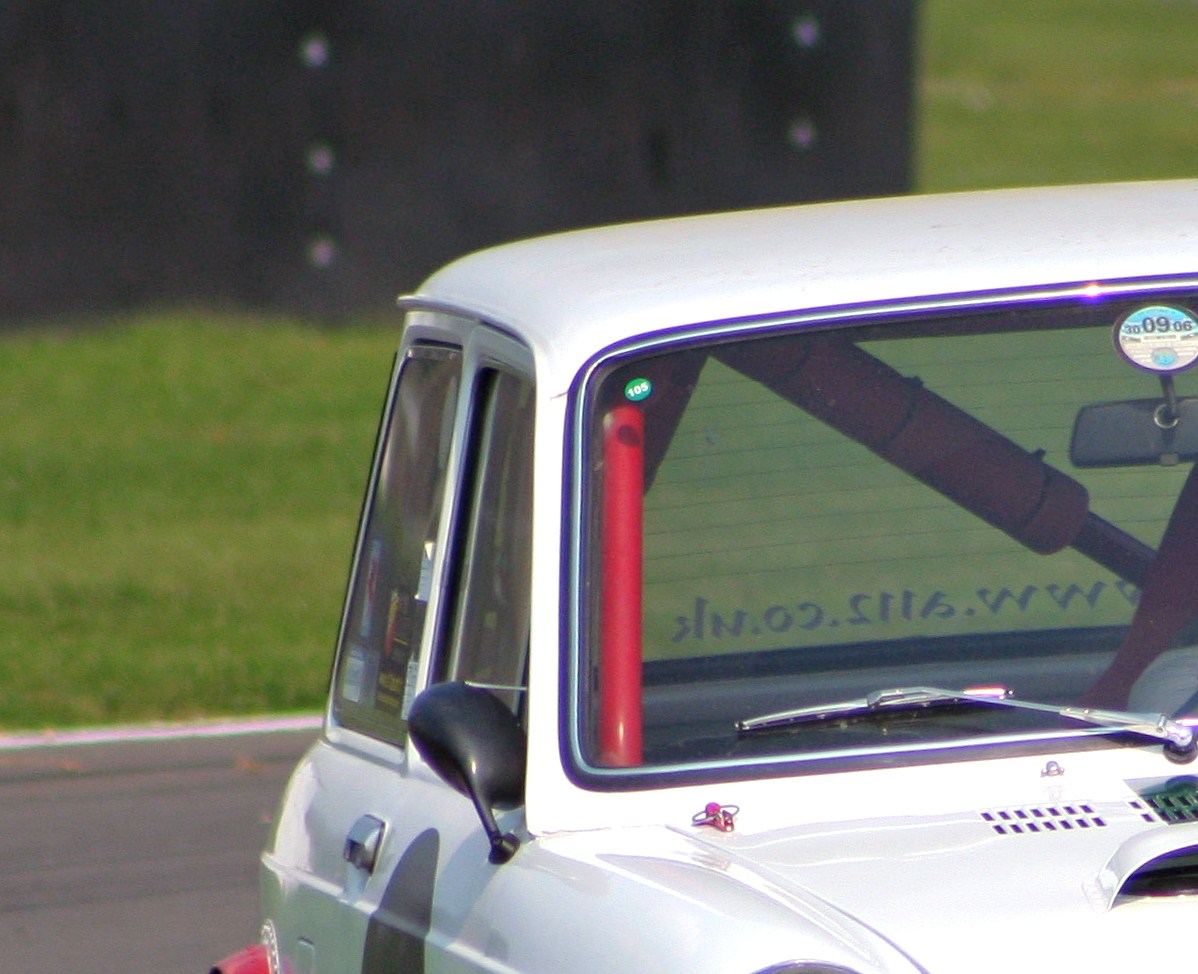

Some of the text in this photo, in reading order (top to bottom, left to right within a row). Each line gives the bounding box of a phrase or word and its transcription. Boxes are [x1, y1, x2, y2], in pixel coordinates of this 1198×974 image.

[1141, 316, 1171, 333] 09
[1173, 320, 1193, 332] 06
[628, 380, 649, 397] 105
